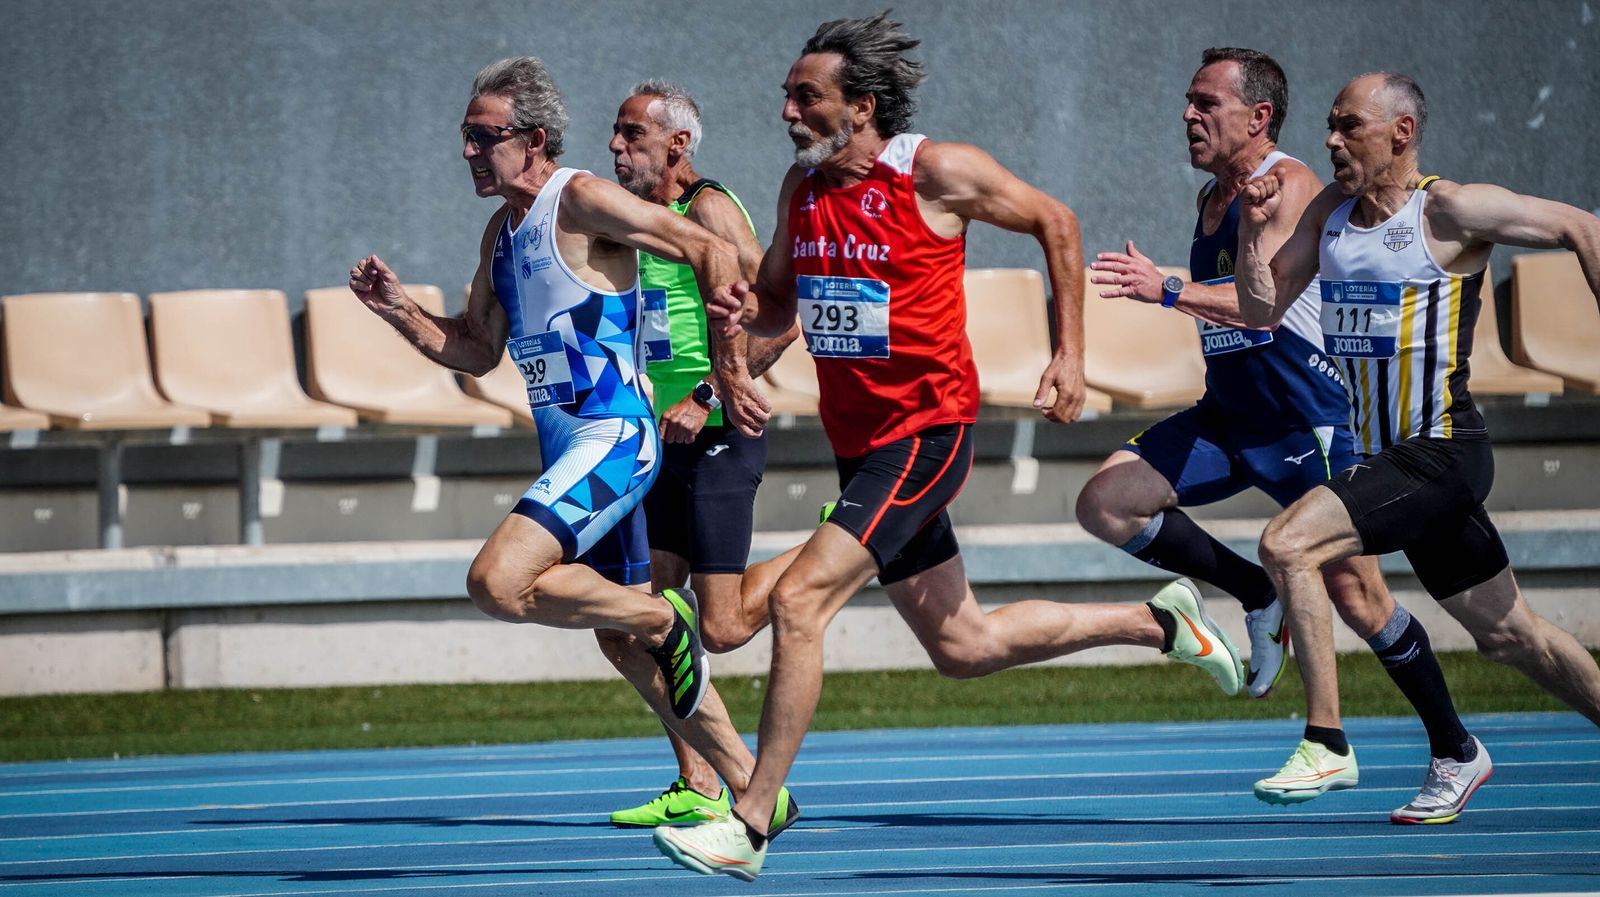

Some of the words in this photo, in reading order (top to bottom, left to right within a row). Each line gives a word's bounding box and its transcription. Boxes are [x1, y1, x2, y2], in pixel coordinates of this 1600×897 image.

[793, 234, 837, 258] Santa
[843, 233, 891, 261] Cruz
[1344, 284, 1378, 293] LOTERÍAS
[811, 303, 859, 332] 293
[1335, 307, 1373, 333] 111
[528, 387, 551, 404] oma
